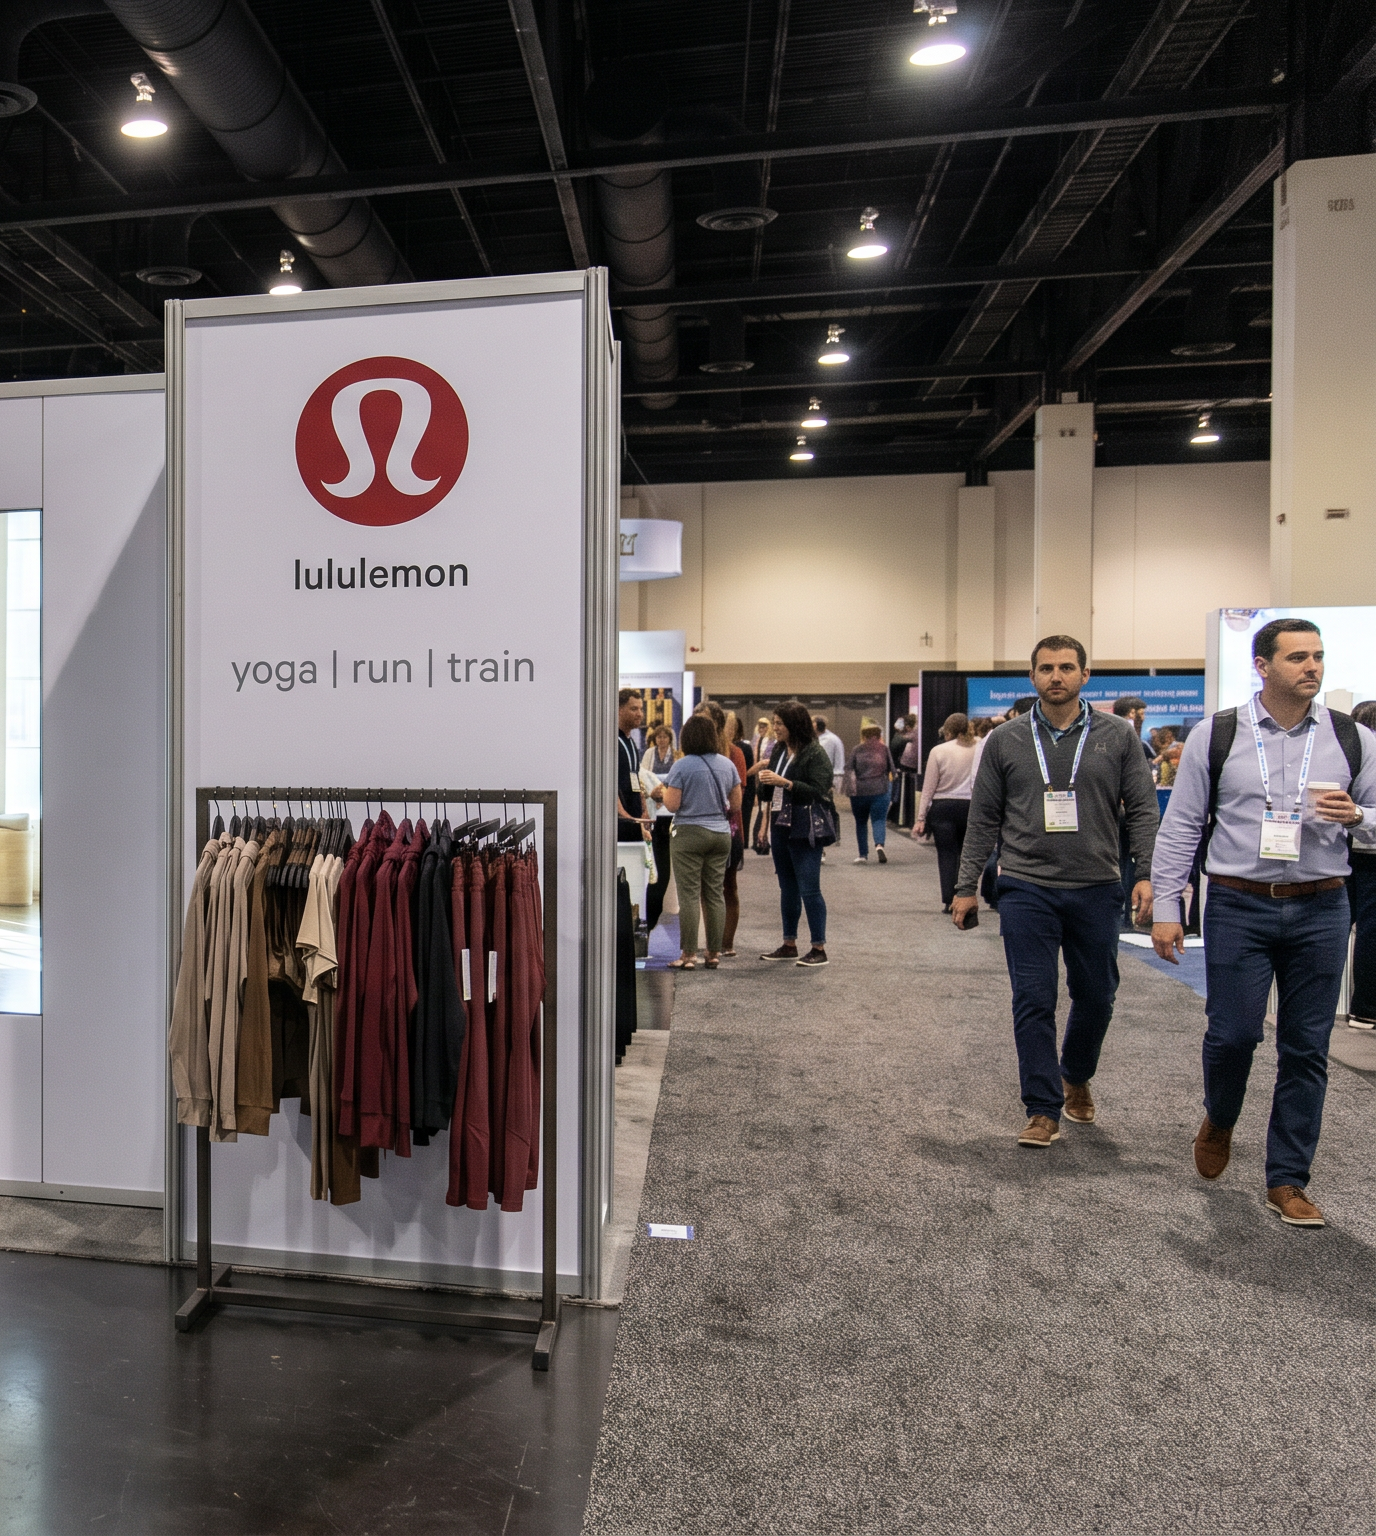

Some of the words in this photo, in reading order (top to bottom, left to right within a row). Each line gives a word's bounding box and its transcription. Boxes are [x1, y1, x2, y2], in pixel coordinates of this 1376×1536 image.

[294, 557, 469, 590] lululemon
[231, 660, 317, 692] yoga
[353, 659, 412, 684] run
[447, 650, 535, 683] train
